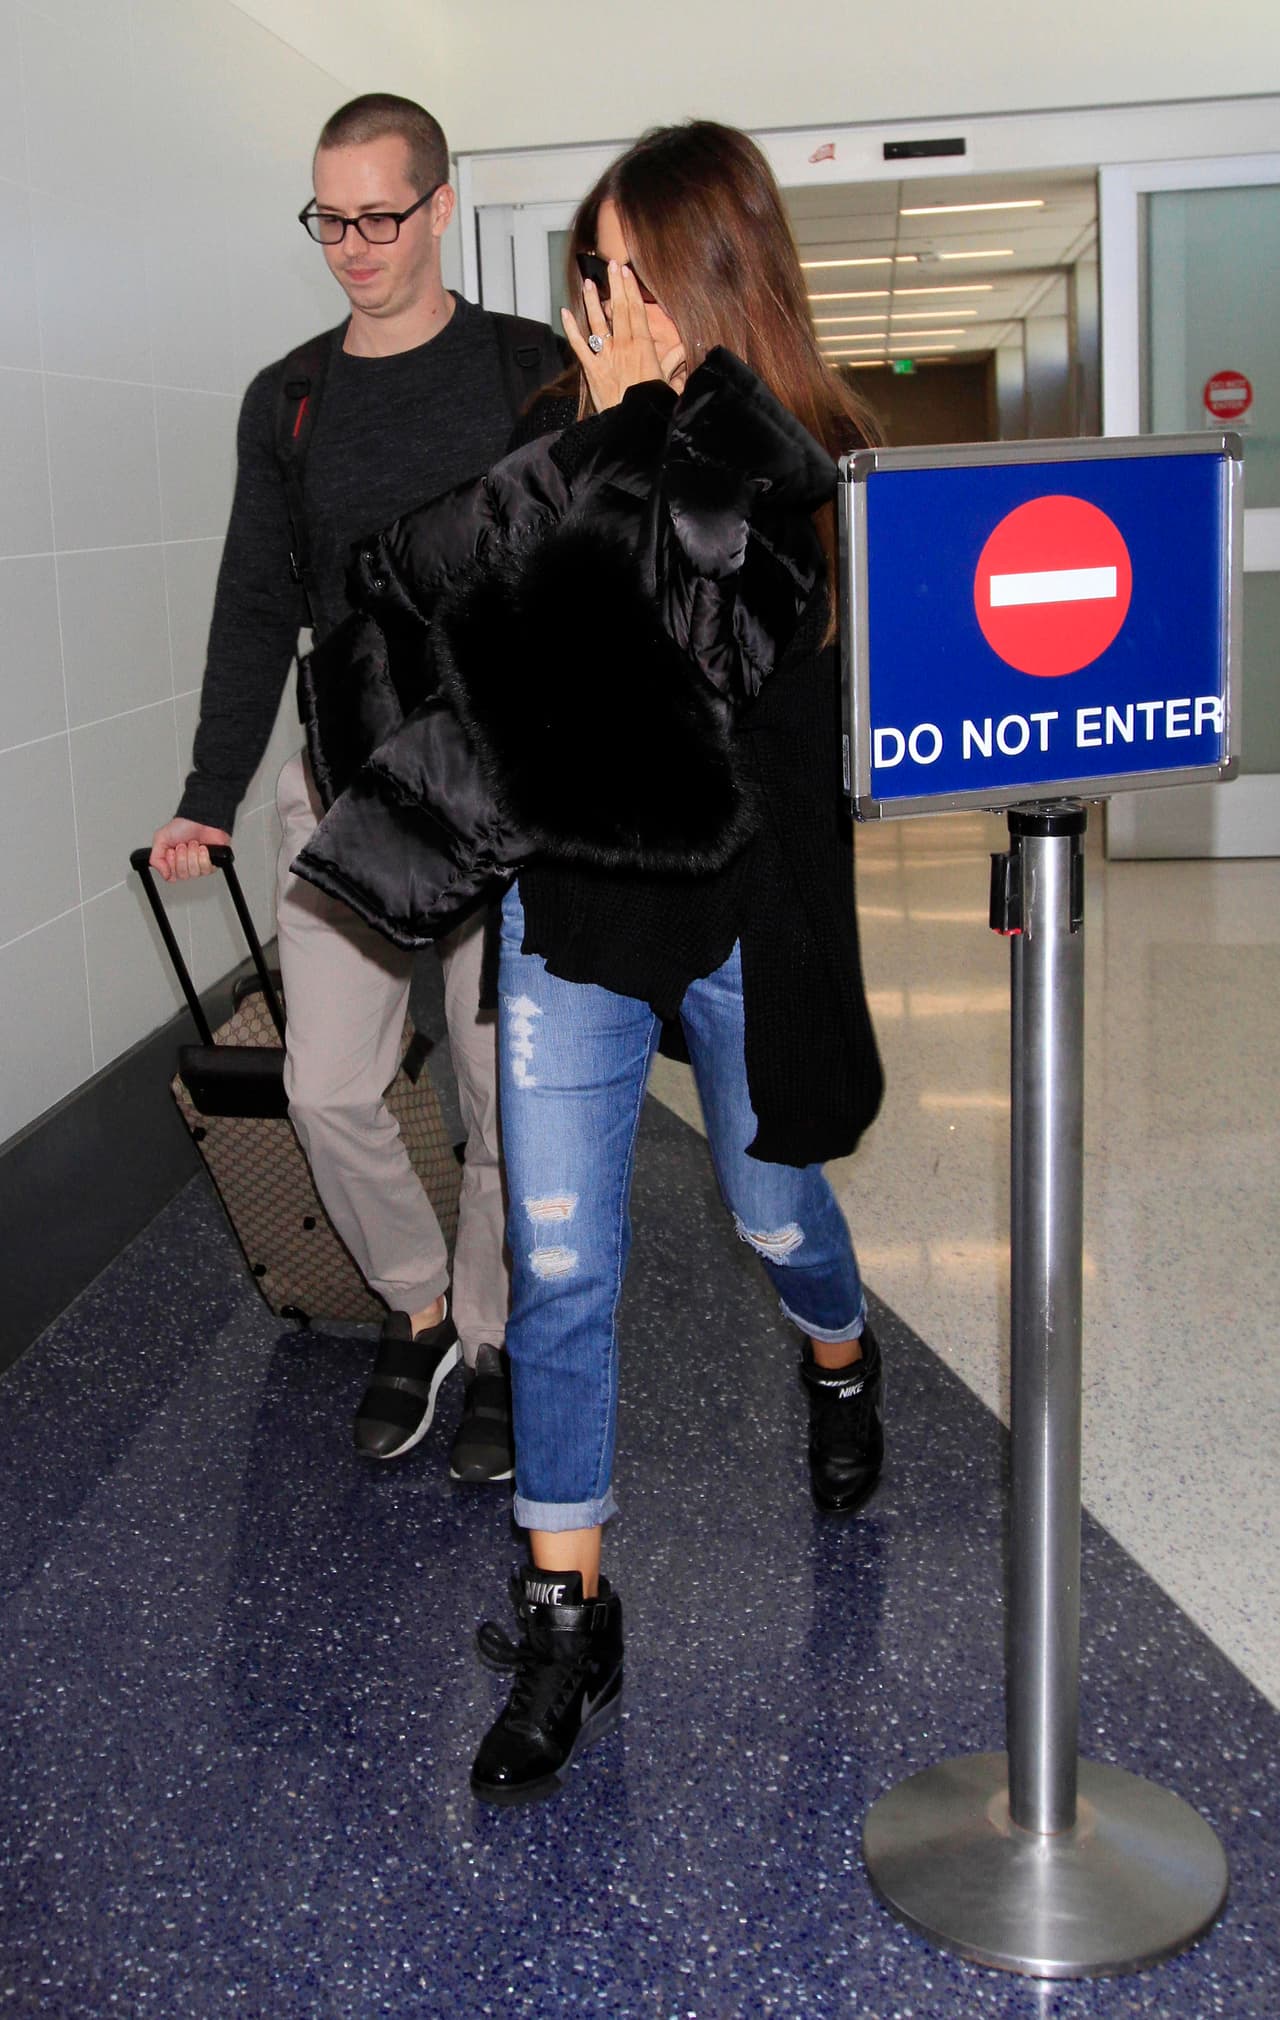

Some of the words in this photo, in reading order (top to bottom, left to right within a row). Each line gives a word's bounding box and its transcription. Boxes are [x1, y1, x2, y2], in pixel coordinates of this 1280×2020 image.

[874, 723, 943, 769] DO
[962, 712, 1058, 760] NOT
[1076, 696, 1223, 748] ENTER
[839, 1381, 864, 1399] NIKE
[526, 1581, 566, 1606] NIKE
